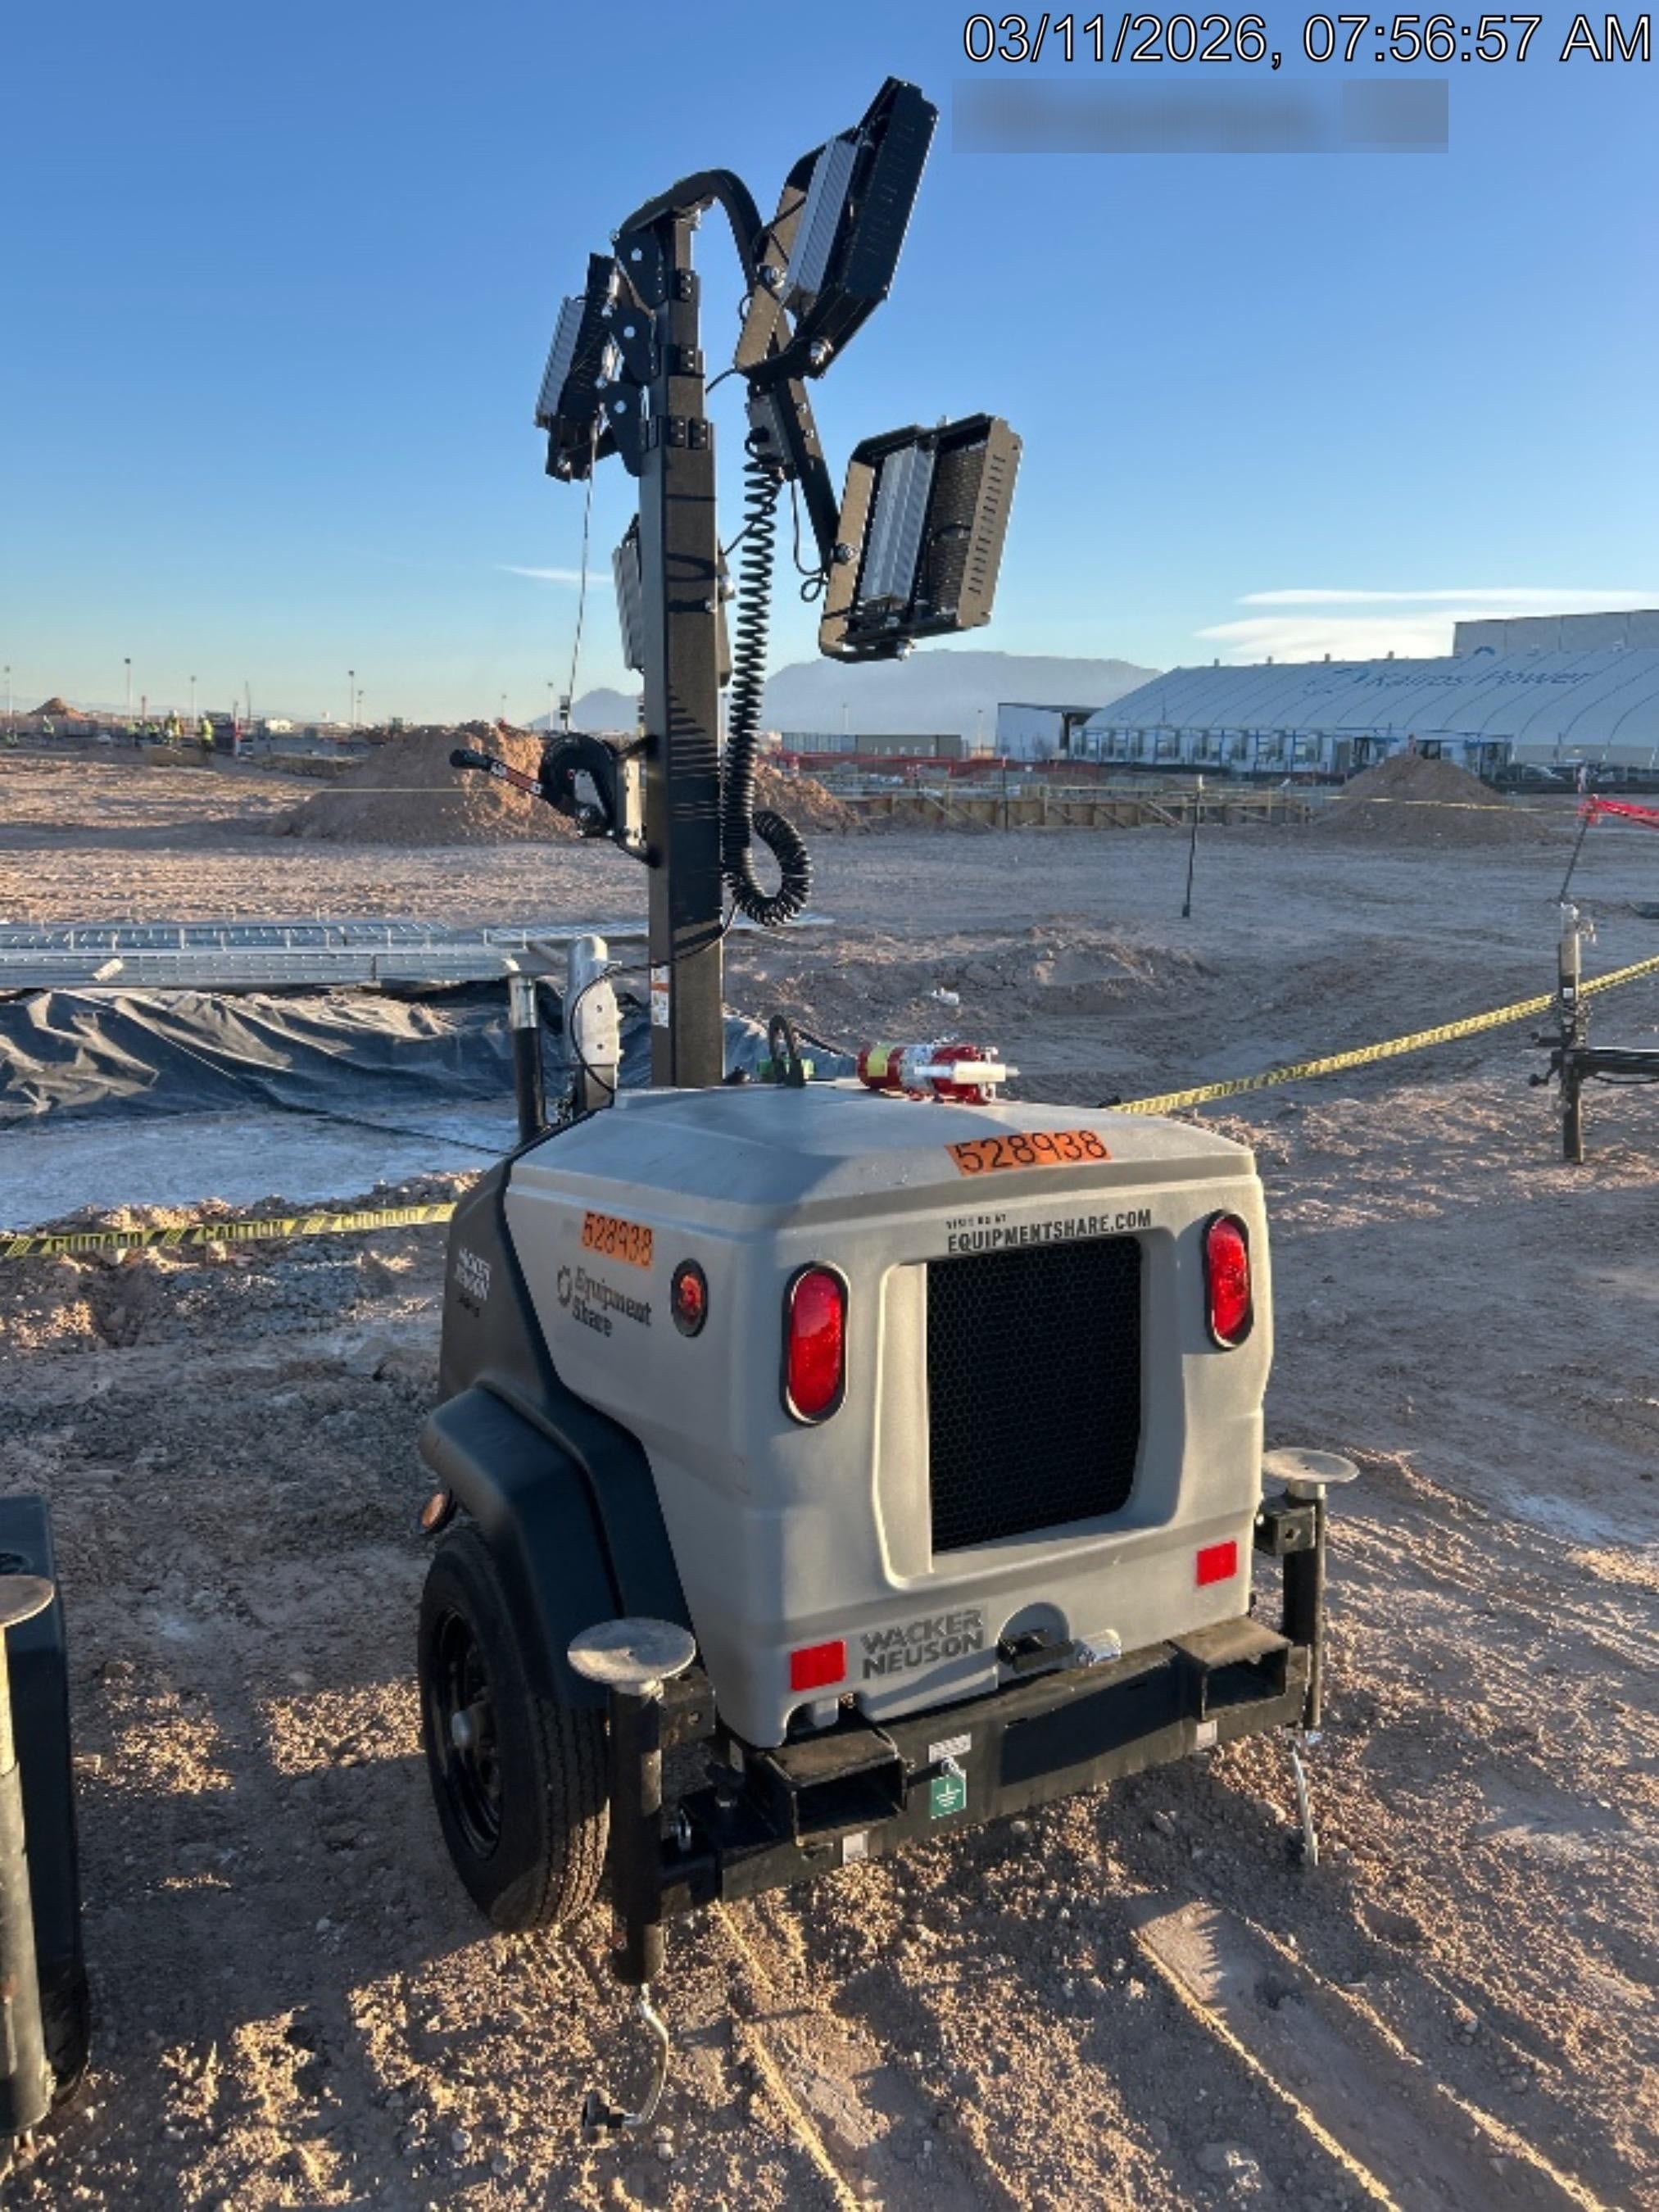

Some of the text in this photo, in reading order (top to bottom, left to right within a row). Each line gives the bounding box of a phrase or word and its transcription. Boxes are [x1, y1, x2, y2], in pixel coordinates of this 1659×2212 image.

[954, 1130, 1107, 1172] 528938
[582, 1211, 653, 1266] 528938
[948, 1208, 1152, 1253] EQUIPMENTSHARE.COM
[575, 1265, 653, 1327] Equipment
[859, 1609, 983, 1654] WACKER
[863, 1630, 983, 1679] NEUSON
